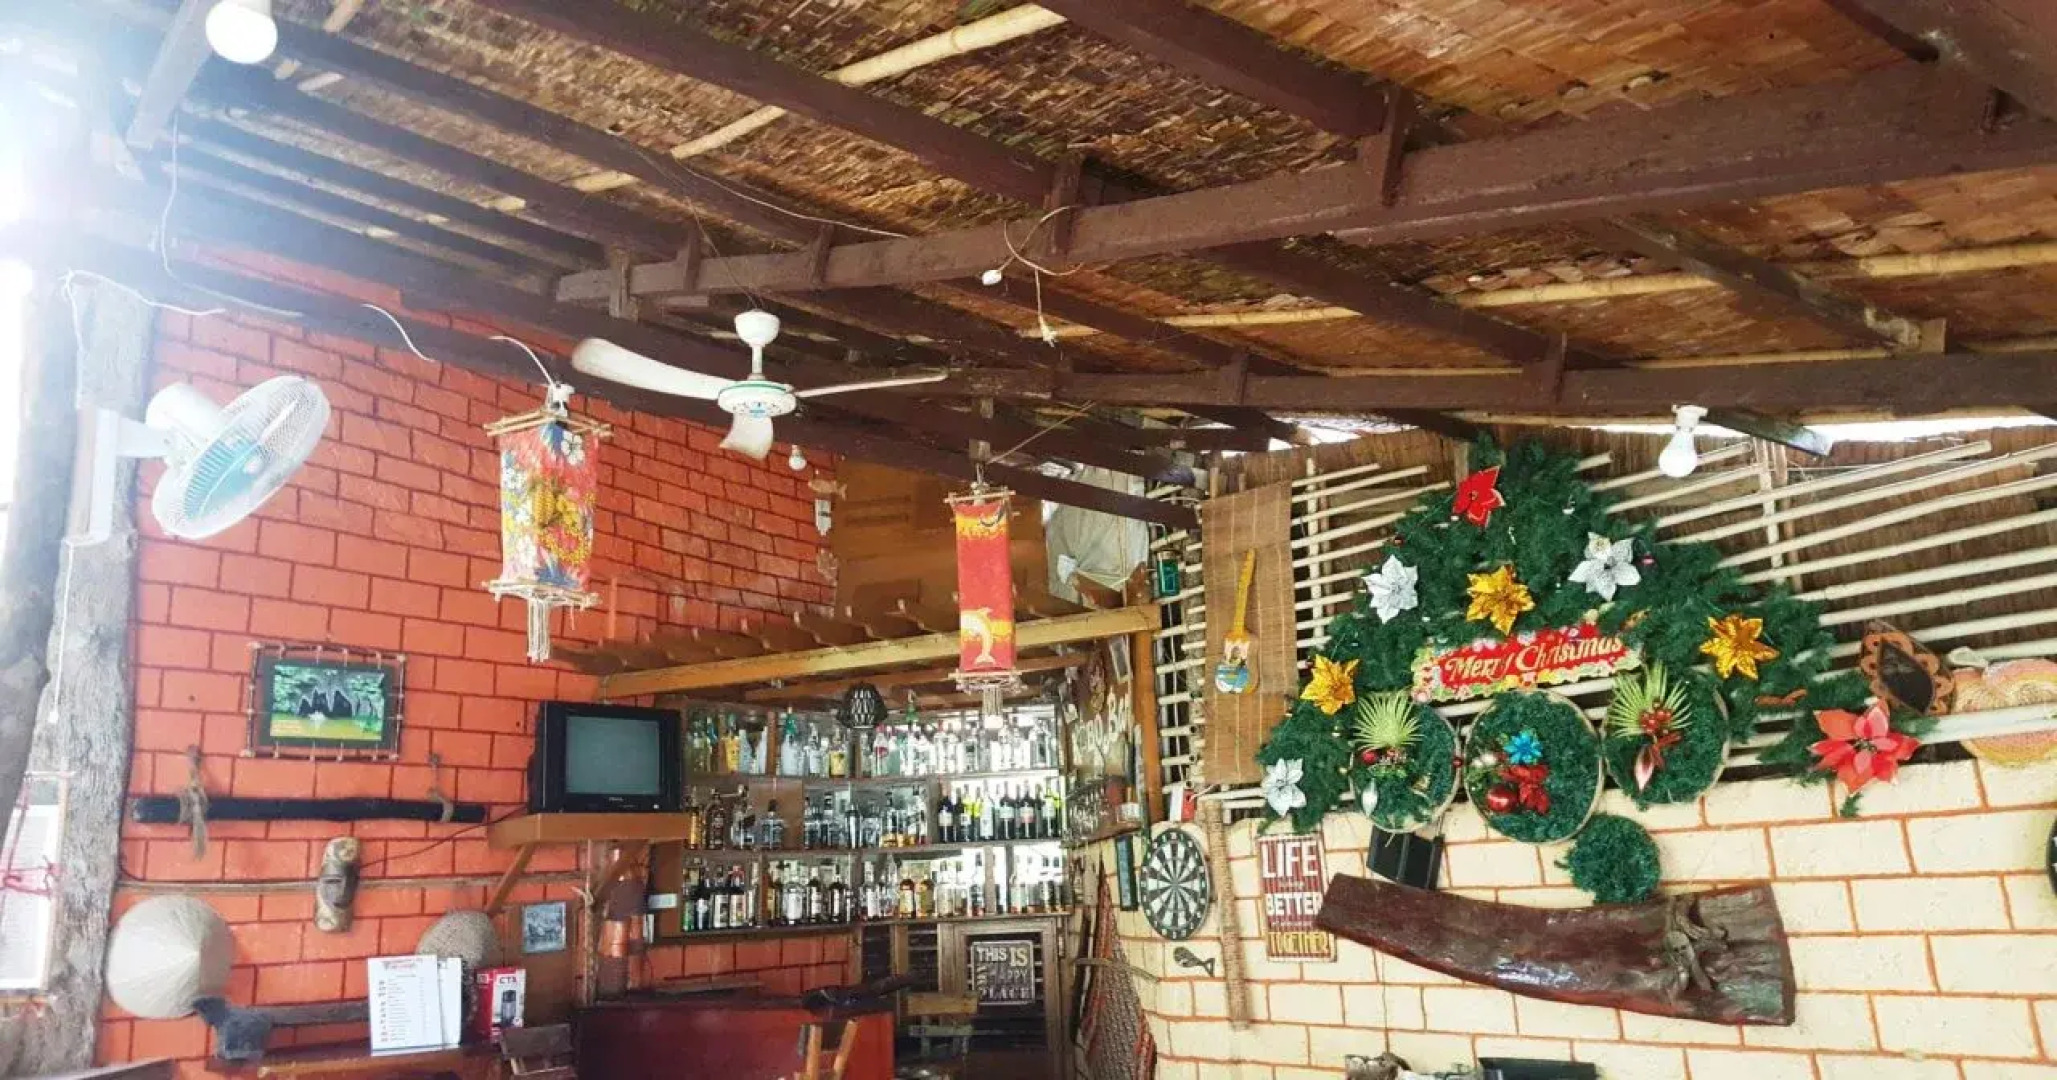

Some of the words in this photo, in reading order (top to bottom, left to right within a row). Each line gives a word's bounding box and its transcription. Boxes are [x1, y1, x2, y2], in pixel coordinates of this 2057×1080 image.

[1445, 652, 1514, 682] Merry
[1516, 636, 1623, 671] Christmas
[1261, 840, 1319, 879] LIFE
[1265, 891, 1324, 915] BETTER
[1267, 931, 1331, 954] TOGETHER
[976, 947, 1007, 962] THIS
[1010, 946, 1028, 967] IS
